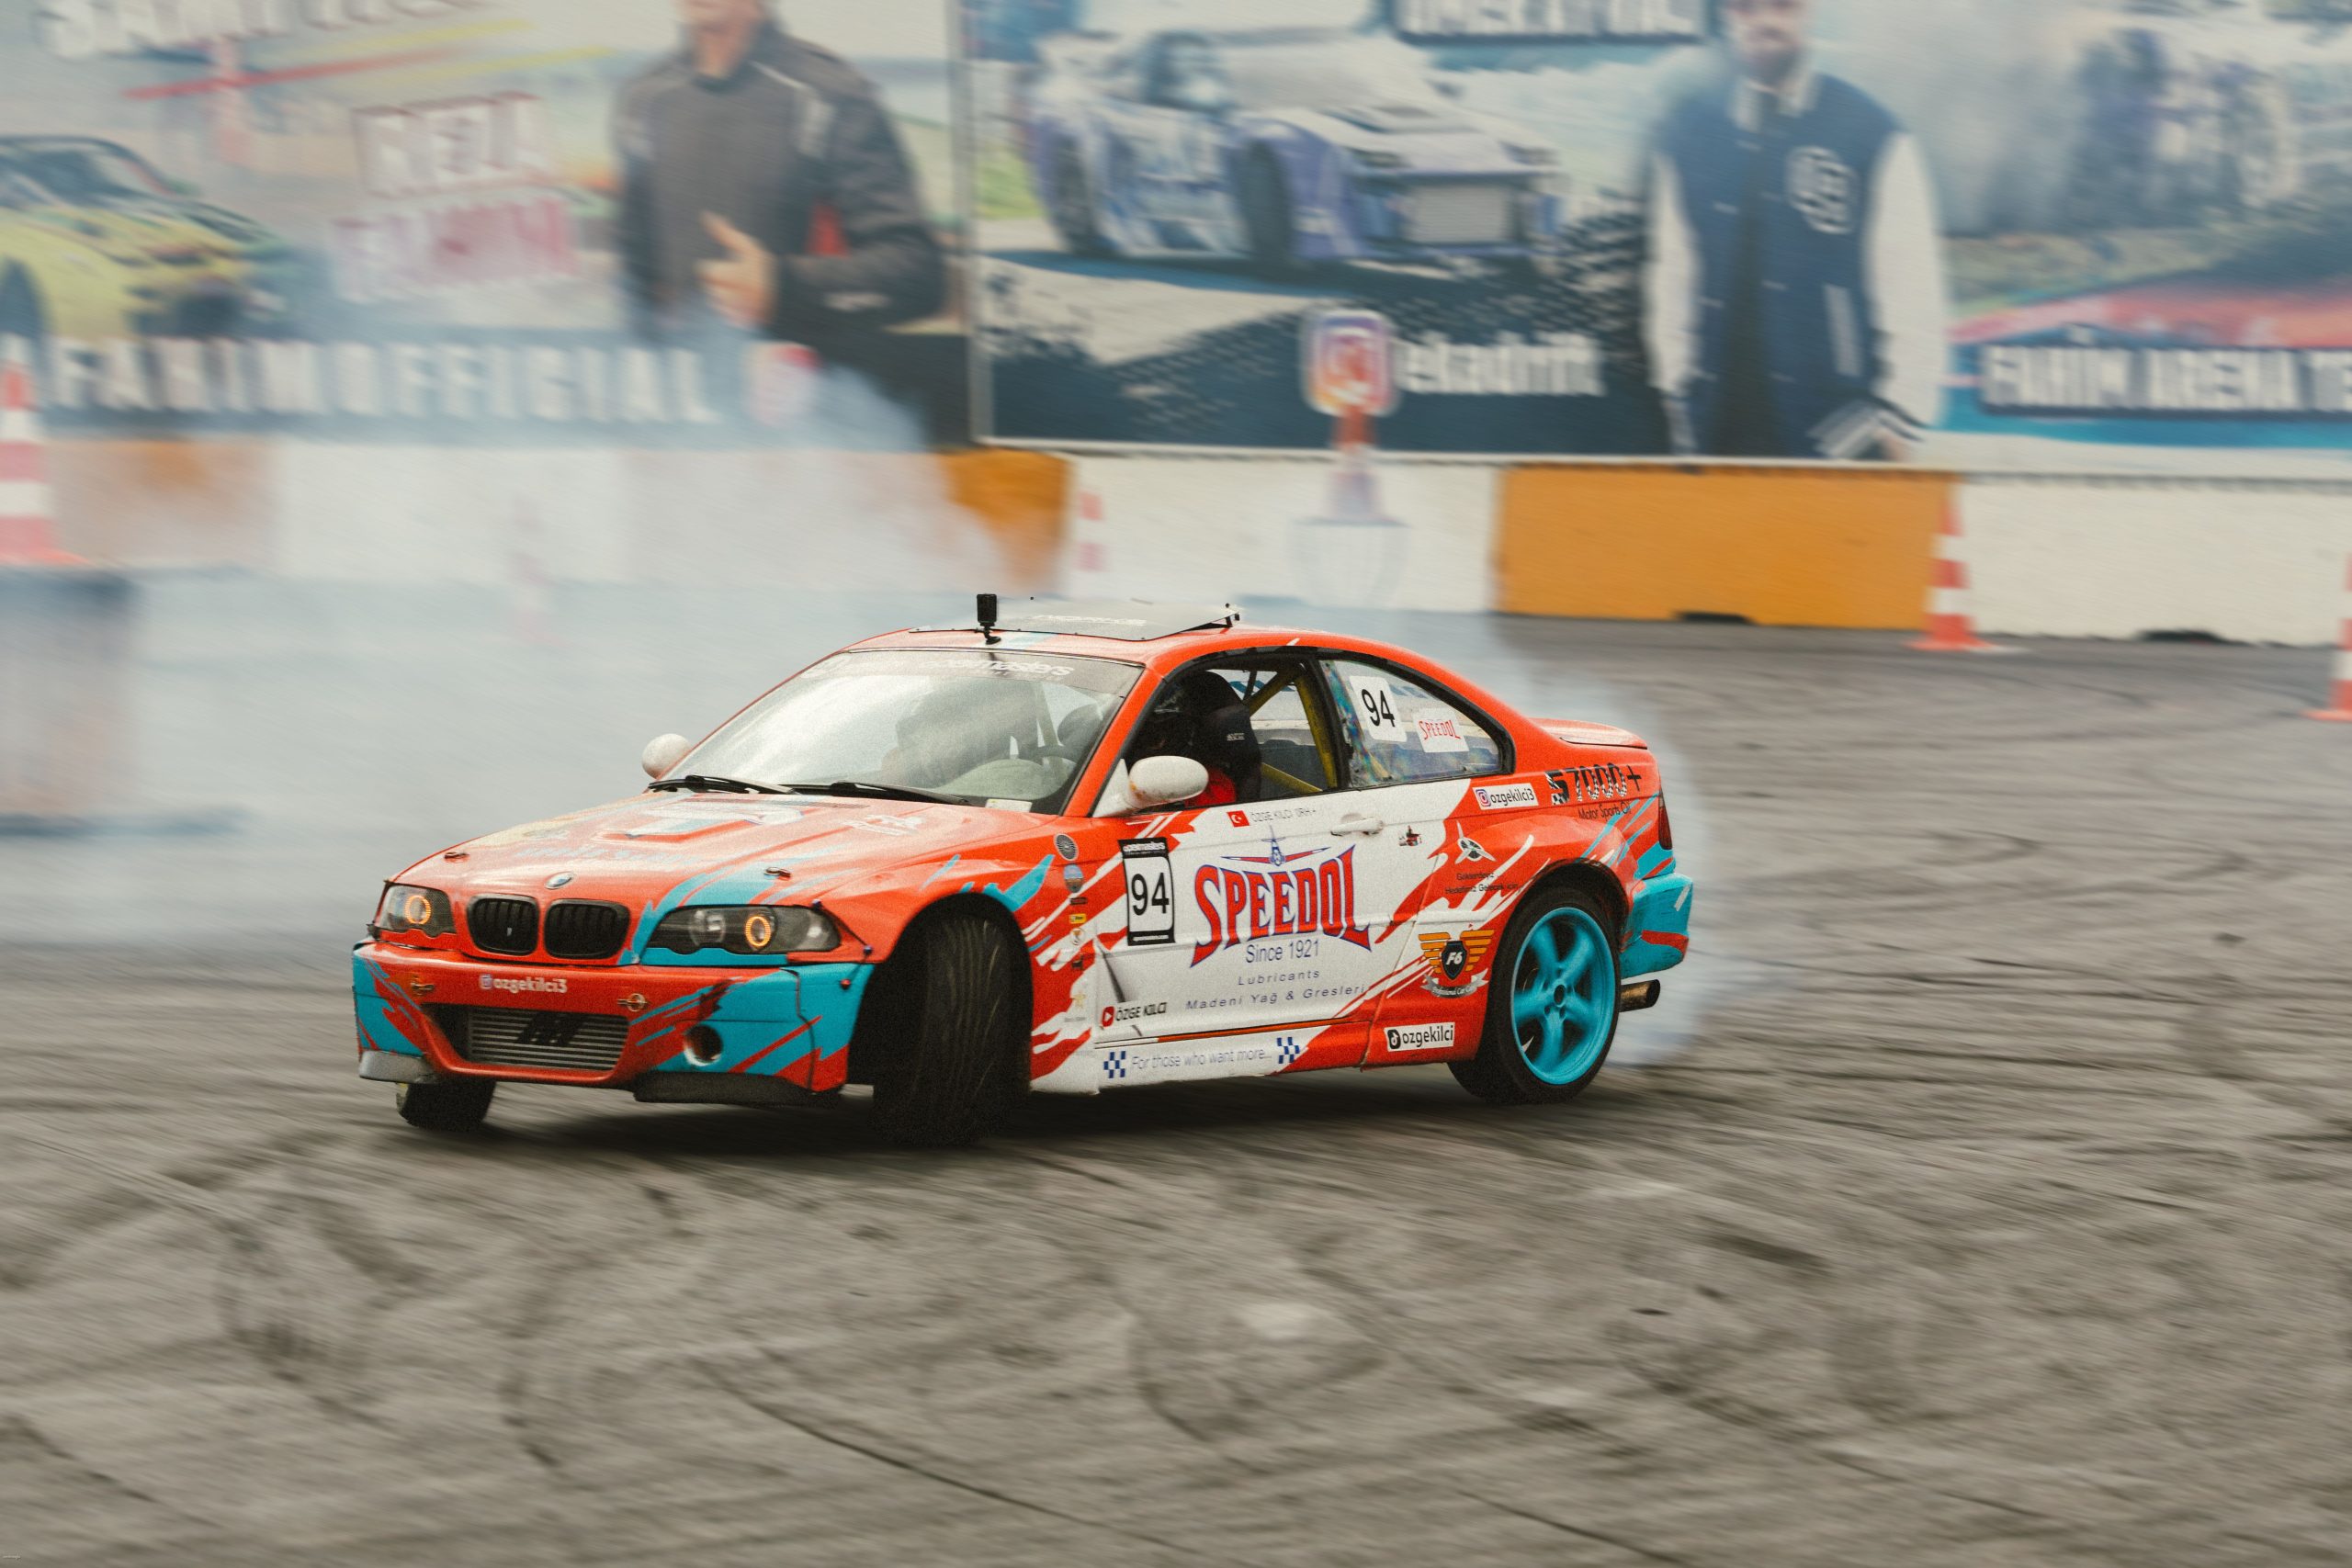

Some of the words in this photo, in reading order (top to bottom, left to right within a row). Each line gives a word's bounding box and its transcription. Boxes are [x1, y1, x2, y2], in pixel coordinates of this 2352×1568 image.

[1362, 689, 1395, 728] 94
[1419, 719, 1461, 740] SPEEDOL
[1490, 788, 1535, 807] ozgekilci3
[1578, 807, 1599, 819] Motor
[1131, 872, 1170, 916] 94
[1191, 844, 1372, 968] SPEEDOL
[1246, 944, 1283, 964] Since
[1289, 939, 1319, 960] 1921
[1445, 952, 1463, 965] F6
[493, 976, 568, 994] ozgekilci3
[1238, 969, 1320, 986] Lubricants
[1185, 996, 1242, 1010] Madeni
[1250, 991, 1278, 1005] Yağ
[1285, 990, 1295, 1000] &
[1303, 984, 1365, 999] Gresleri
[1116, 1007, 1141, 1021] ÖZGE
[1402, 1024, 1453, 1048] ozgekilci
[1131, 1055, 1150, 1069] For
[1151, 1054, 1182, 1068] those
[1183, 1053, 1206, 1066] who
[1209, 1051, 1234, 1063] want
